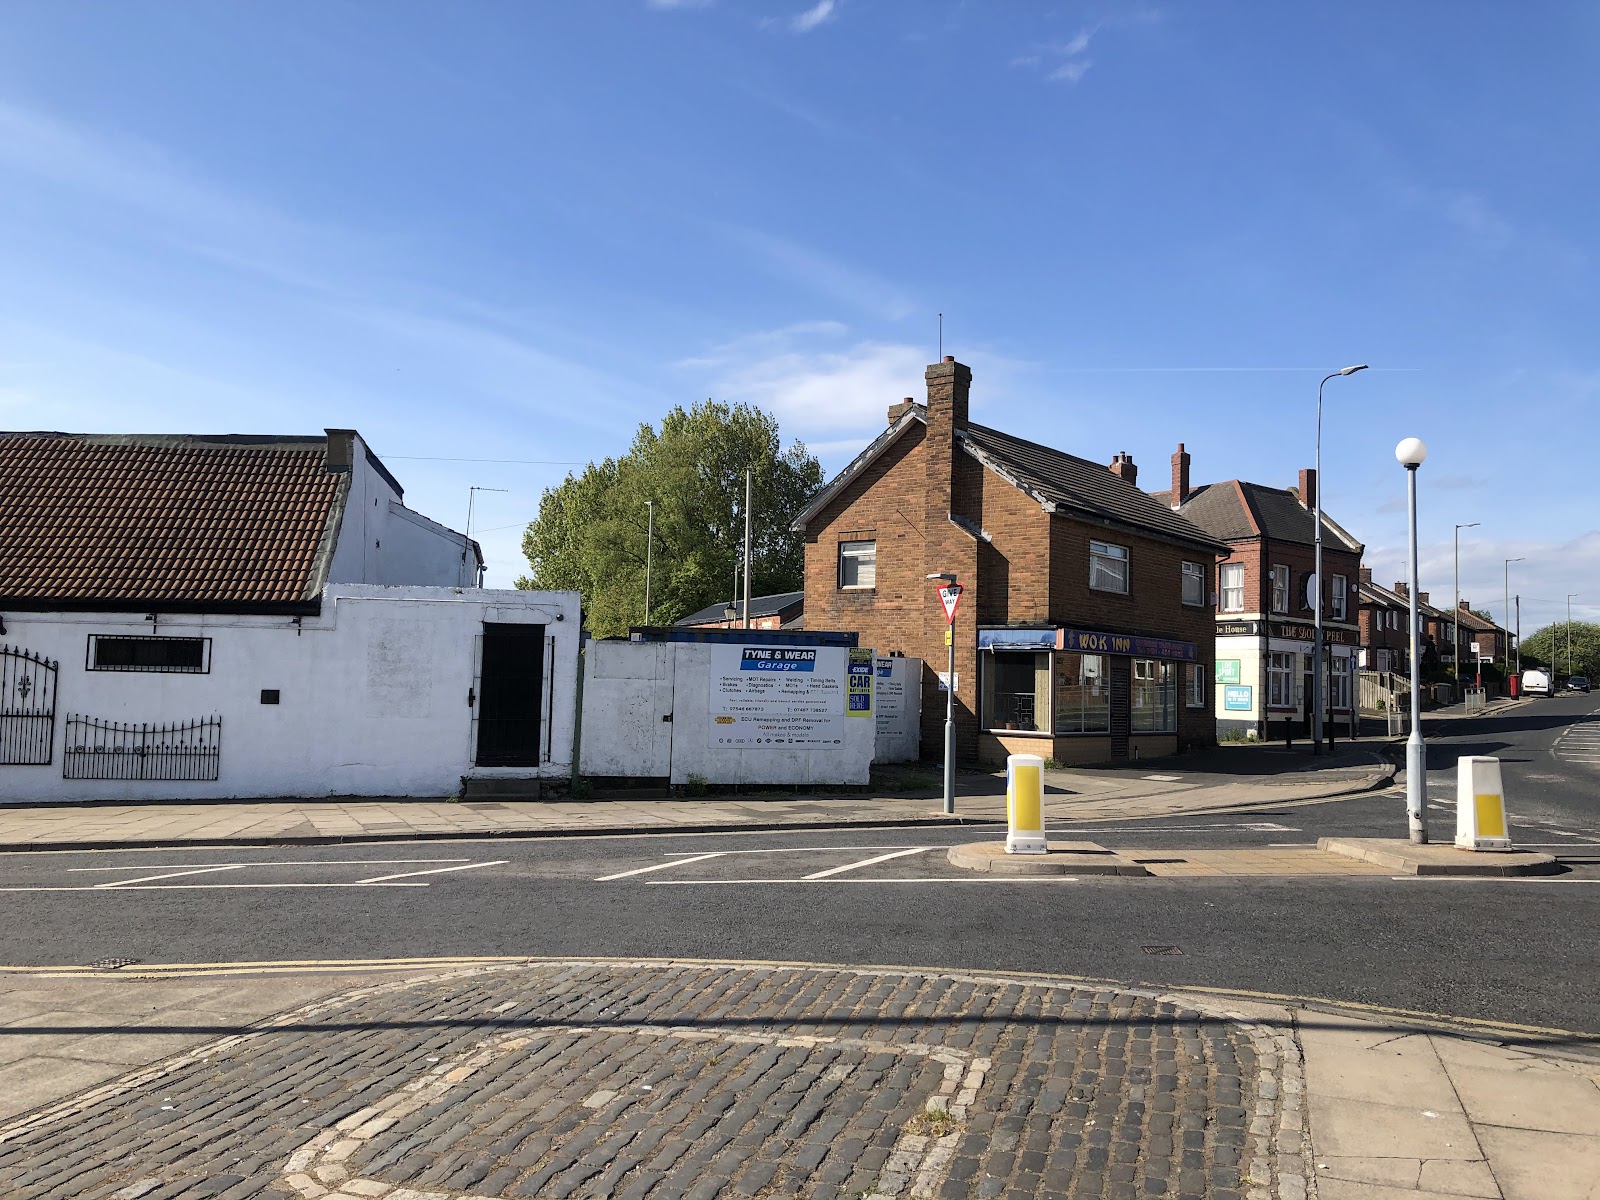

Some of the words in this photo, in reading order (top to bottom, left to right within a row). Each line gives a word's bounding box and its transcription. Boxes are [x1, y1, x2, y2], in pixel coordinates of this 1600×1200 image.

[943, 589, 957, 597] GIVE
[1225, 626, 1247, 634] House
[1281, 624, 1297, 638] THE
[1299, 626, 1325, 641] DOL
[1326, 630, 1345, 642] PEEL
[1079, 634, 1108, 651] WOK
[1111, 636, 1131, 652] INN
[744, 650, 772, 659] TYNE
[774, 650, 782, 660] &
[784, 651, 814, 660] WEAR
[758, 661, 798, 670] Garage
[1218, 668, 1236, 676] SPORT
[850, 675, 870, 688] CAR
